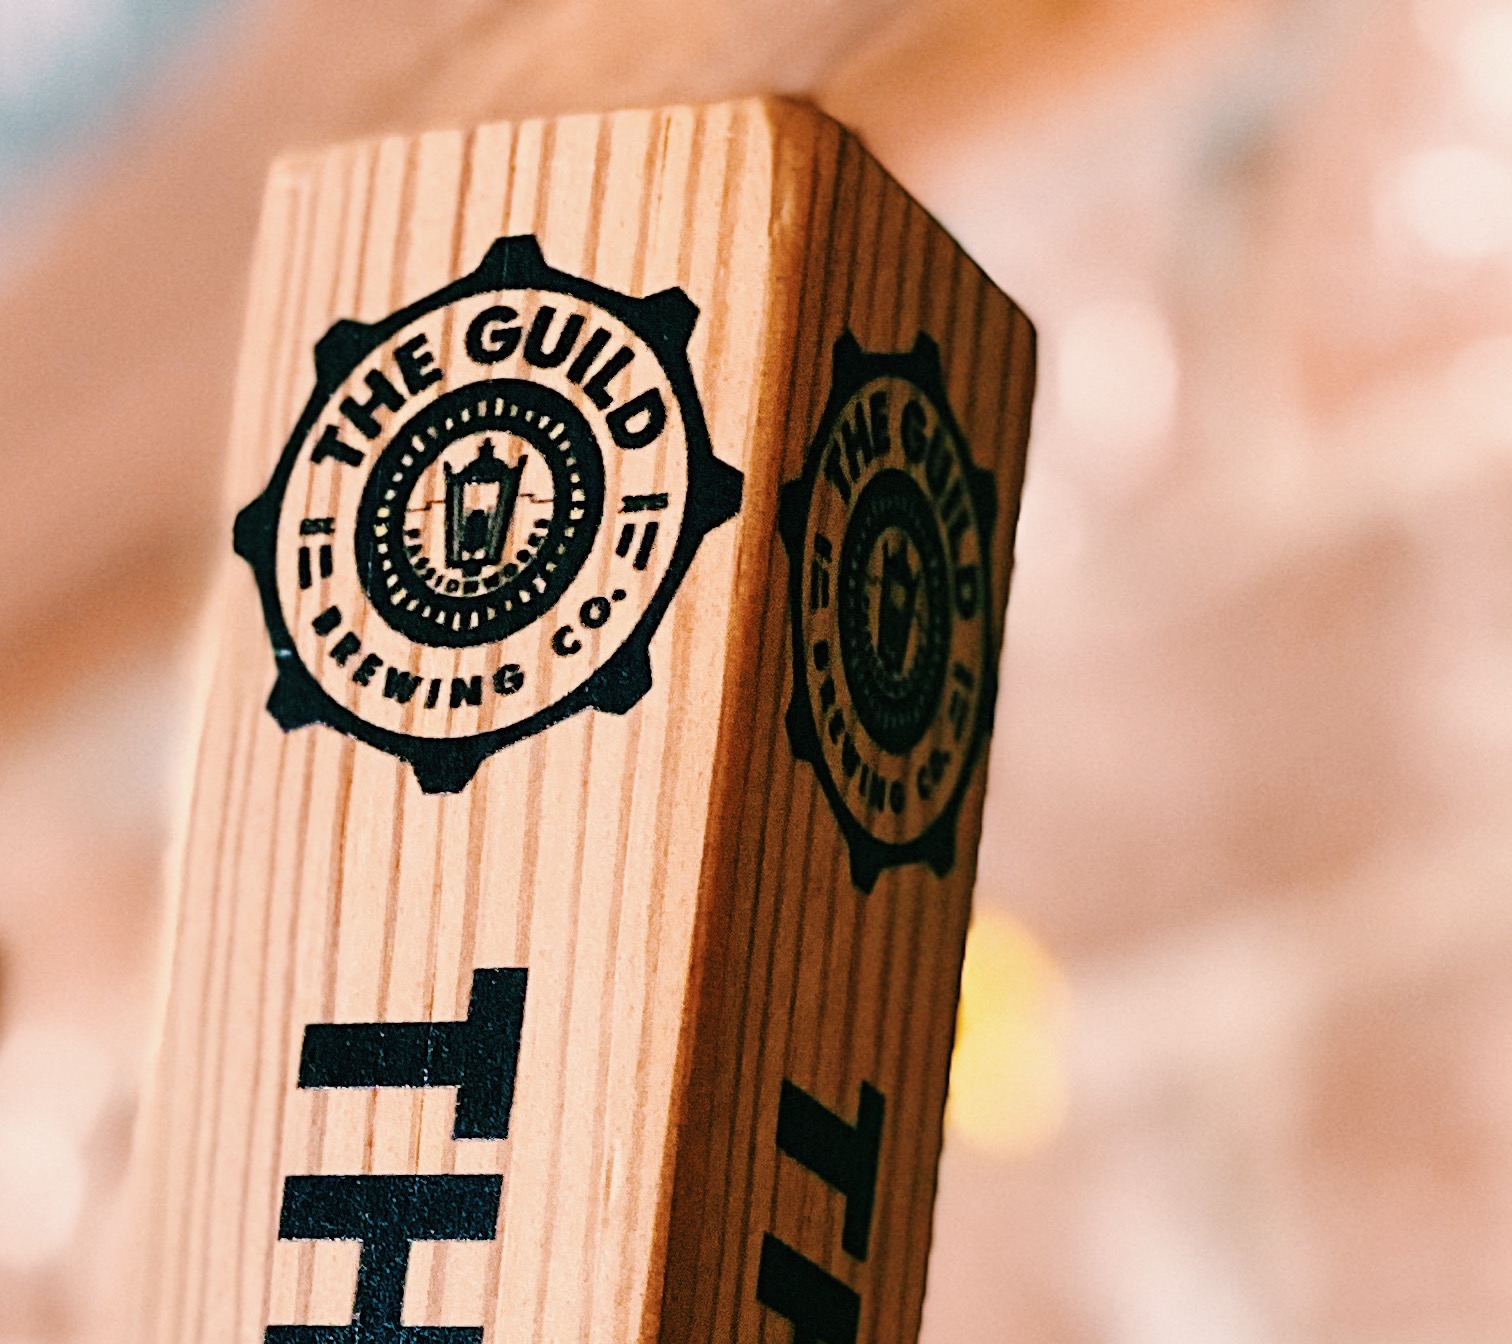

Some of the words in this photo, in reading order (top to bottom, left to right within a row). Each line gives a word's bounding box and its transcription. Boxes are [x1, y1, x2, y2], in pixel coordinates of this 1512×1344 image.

[310, 333, 443, 467] THE
[465, 304, 667, 449] GUILD
[824, 391, 889, 503] THE
[901, 400, 979, 620] GUILD
[312, 606, 524, 709] BREWING
